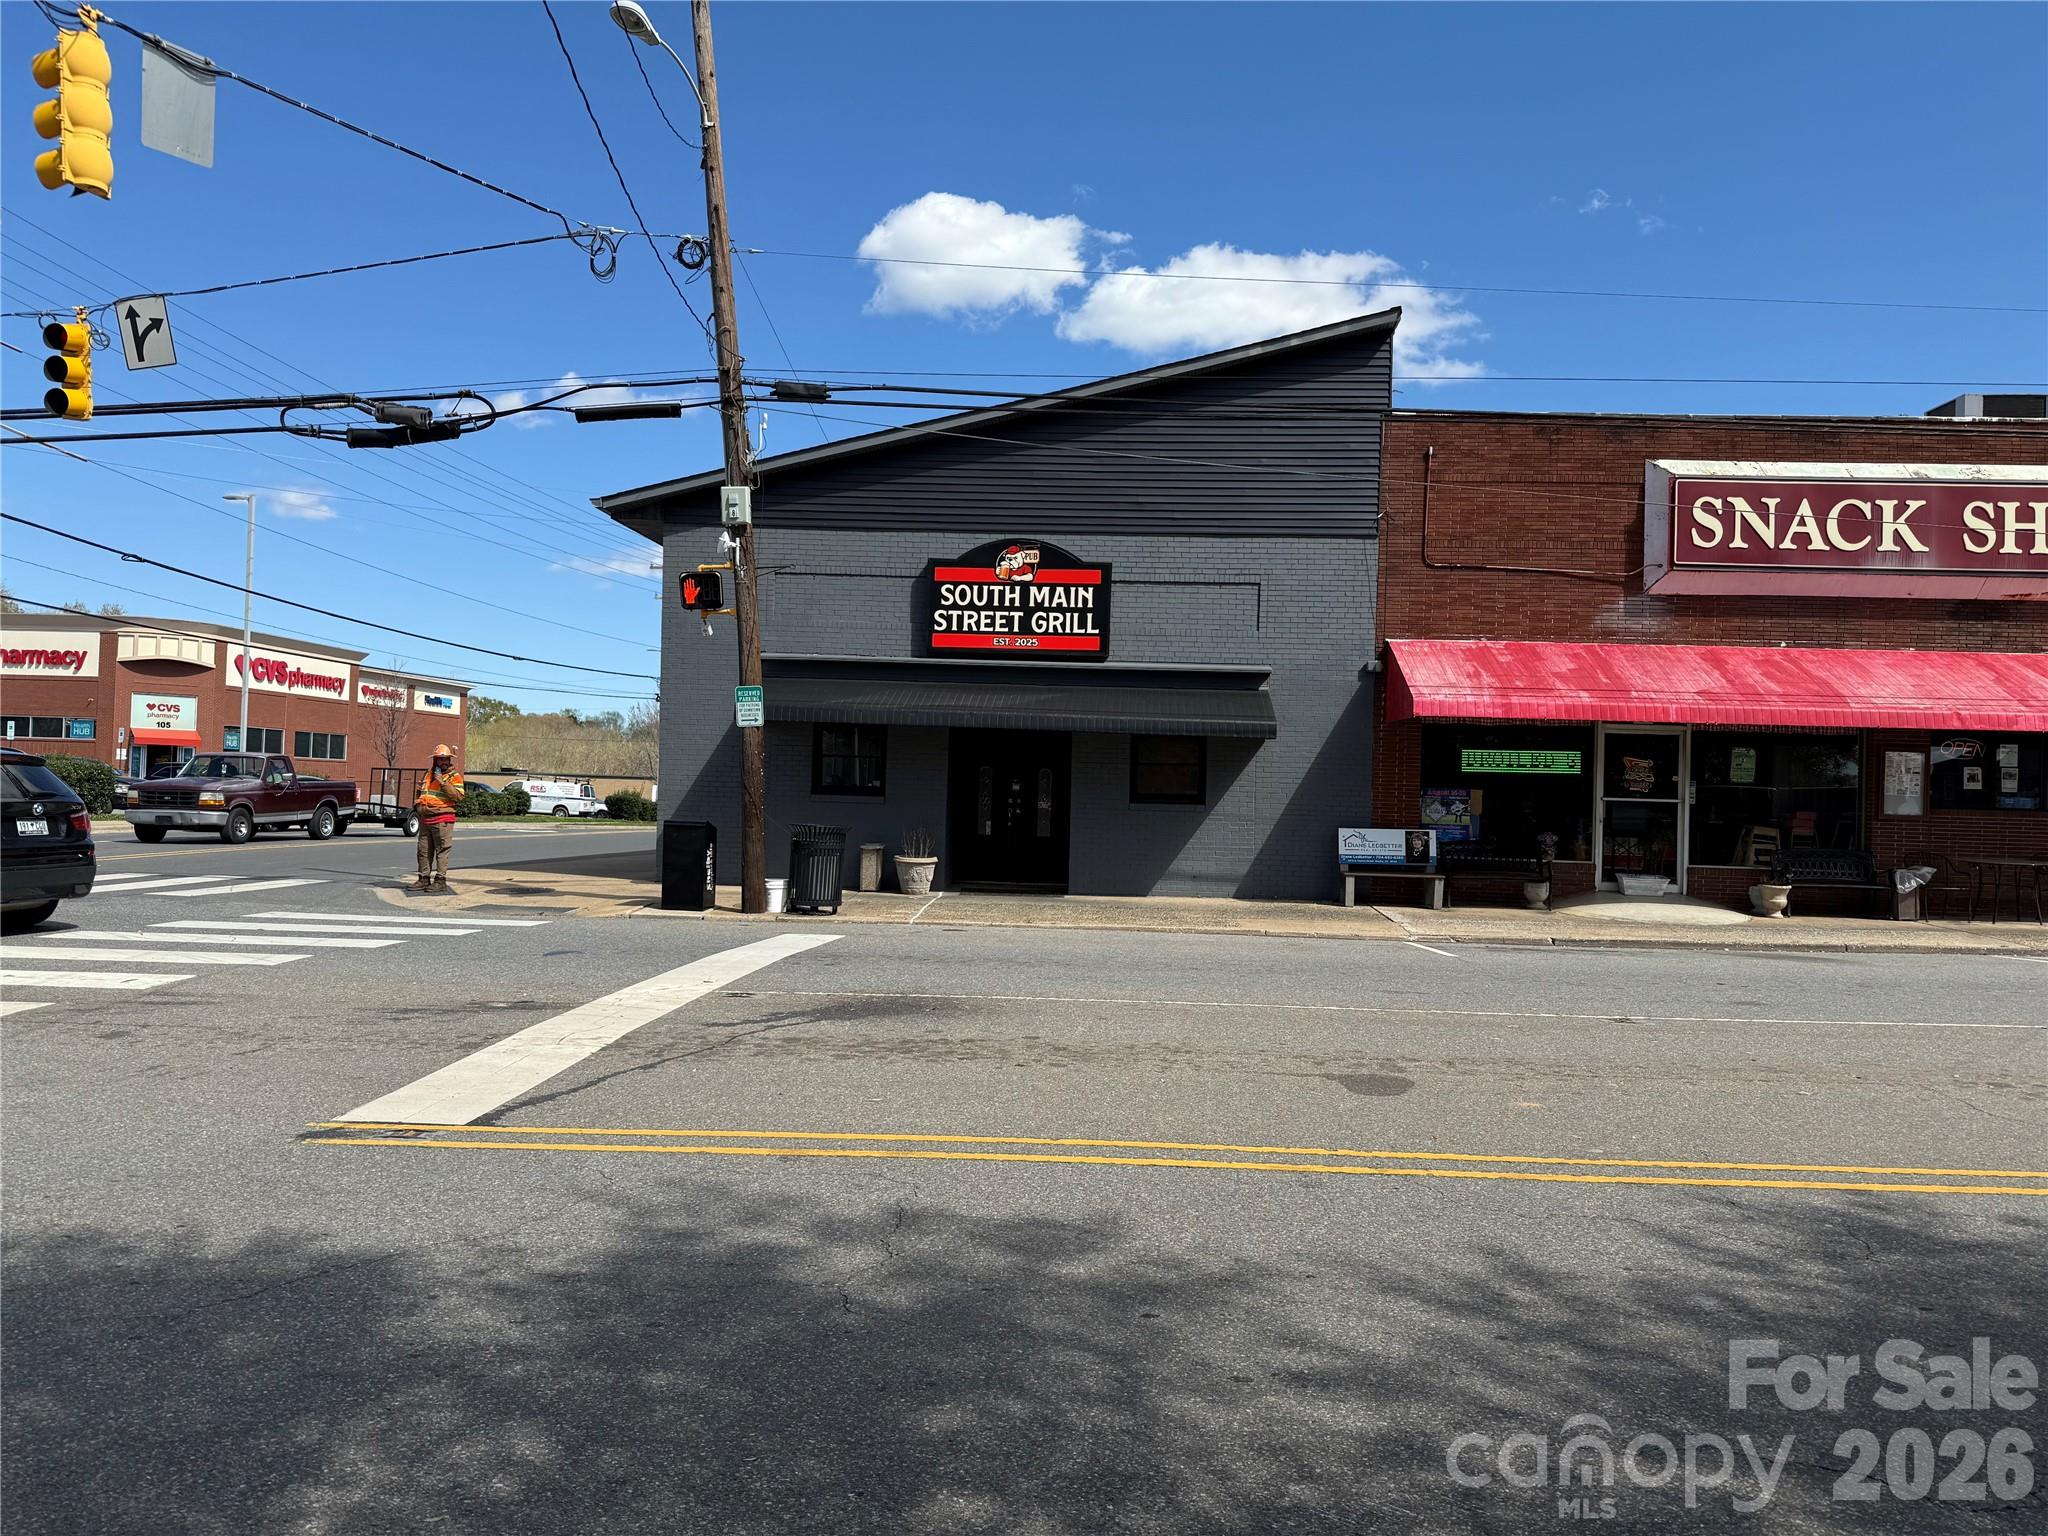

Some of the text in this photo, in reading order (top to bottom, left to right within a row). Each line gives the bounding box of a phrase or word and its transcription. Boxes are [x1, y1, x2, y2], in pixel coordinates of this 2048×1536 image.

[1690, 496, 2048, 555] SNACK SH
[1024, 551, 1038, 561] PUB
[940, 584, 1094, 608] SOUTH MAIN
[933, 609, 1100, 634] STREET GRILL
[993, 637, 1038, 647] EST. 2025
[252, 658, 288, 684] CVS
[288, 667, 346, 696] pharmacy
[157, 703, 181, 713] CVS
[147, 712, 180, 721] pharmacy
[156, 721, 171, 729] 105
[73, 727, 90, 735] HUB
[1940, 740, 1985, 758] OPEN
